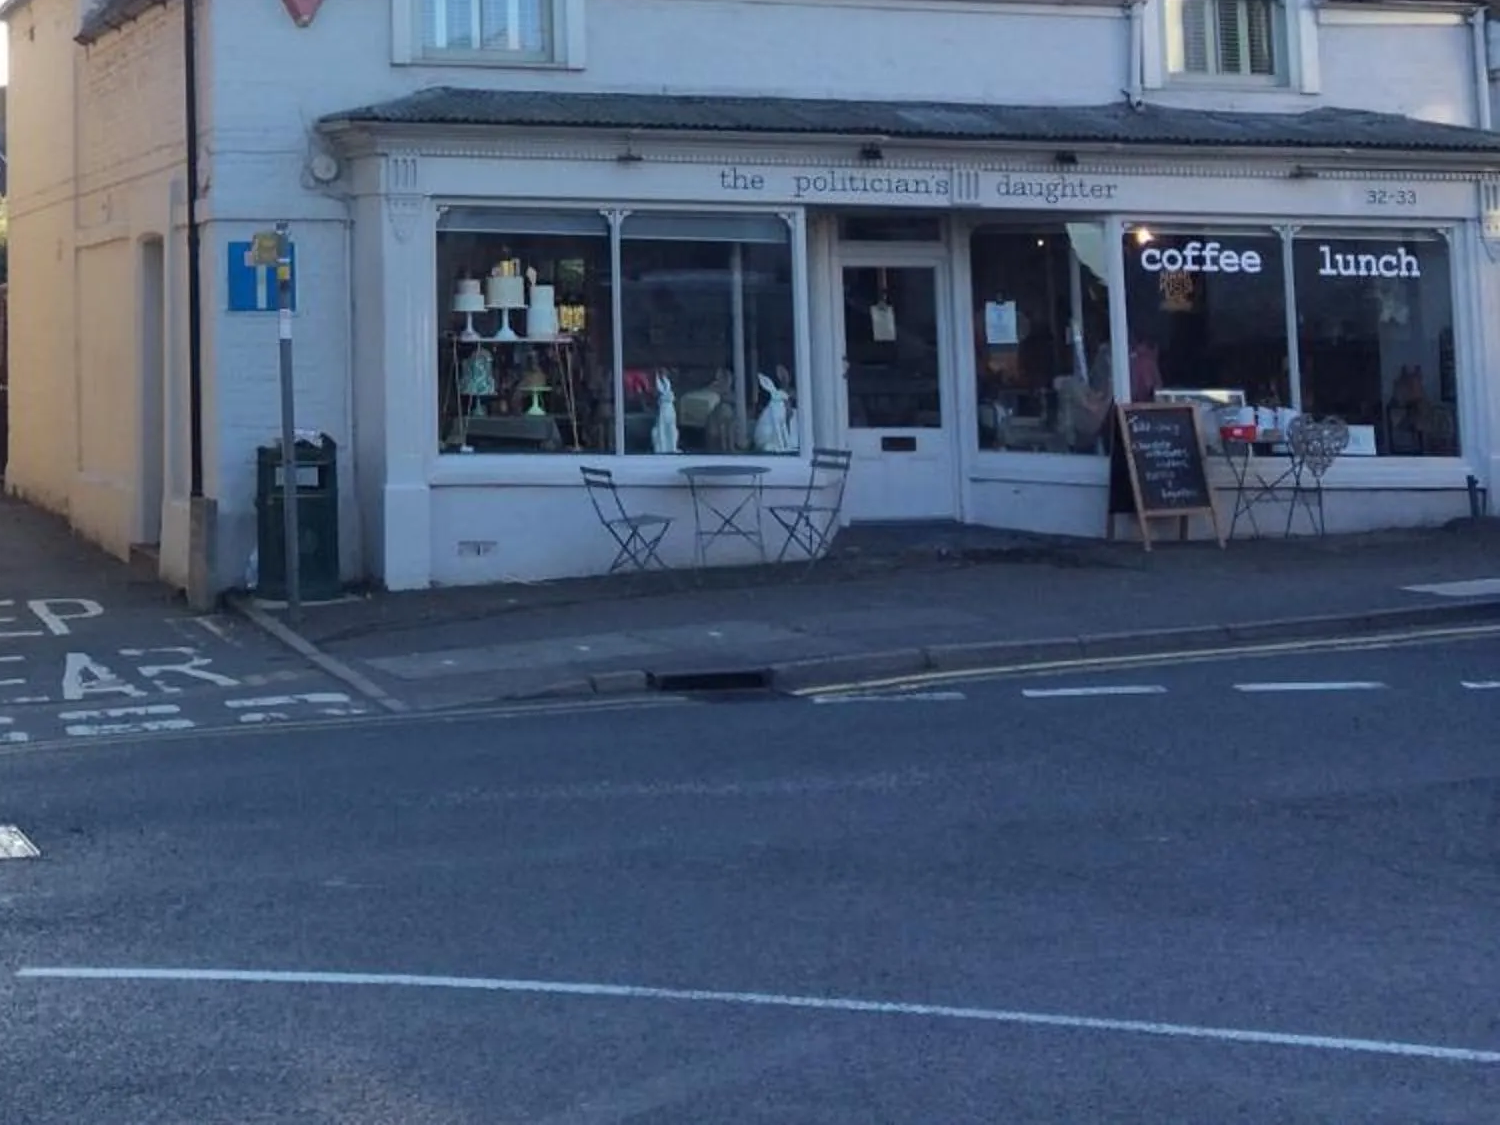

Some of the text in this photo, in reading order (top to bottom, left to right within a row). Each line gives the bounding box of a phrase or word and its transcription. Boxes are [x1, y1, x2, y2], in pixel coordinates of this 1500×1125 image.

[720, 166, 1118, 203] the politician's daughter
[1140, 242, 1263, 274] coffee
[1318, 245, 1421, 277] lunch
